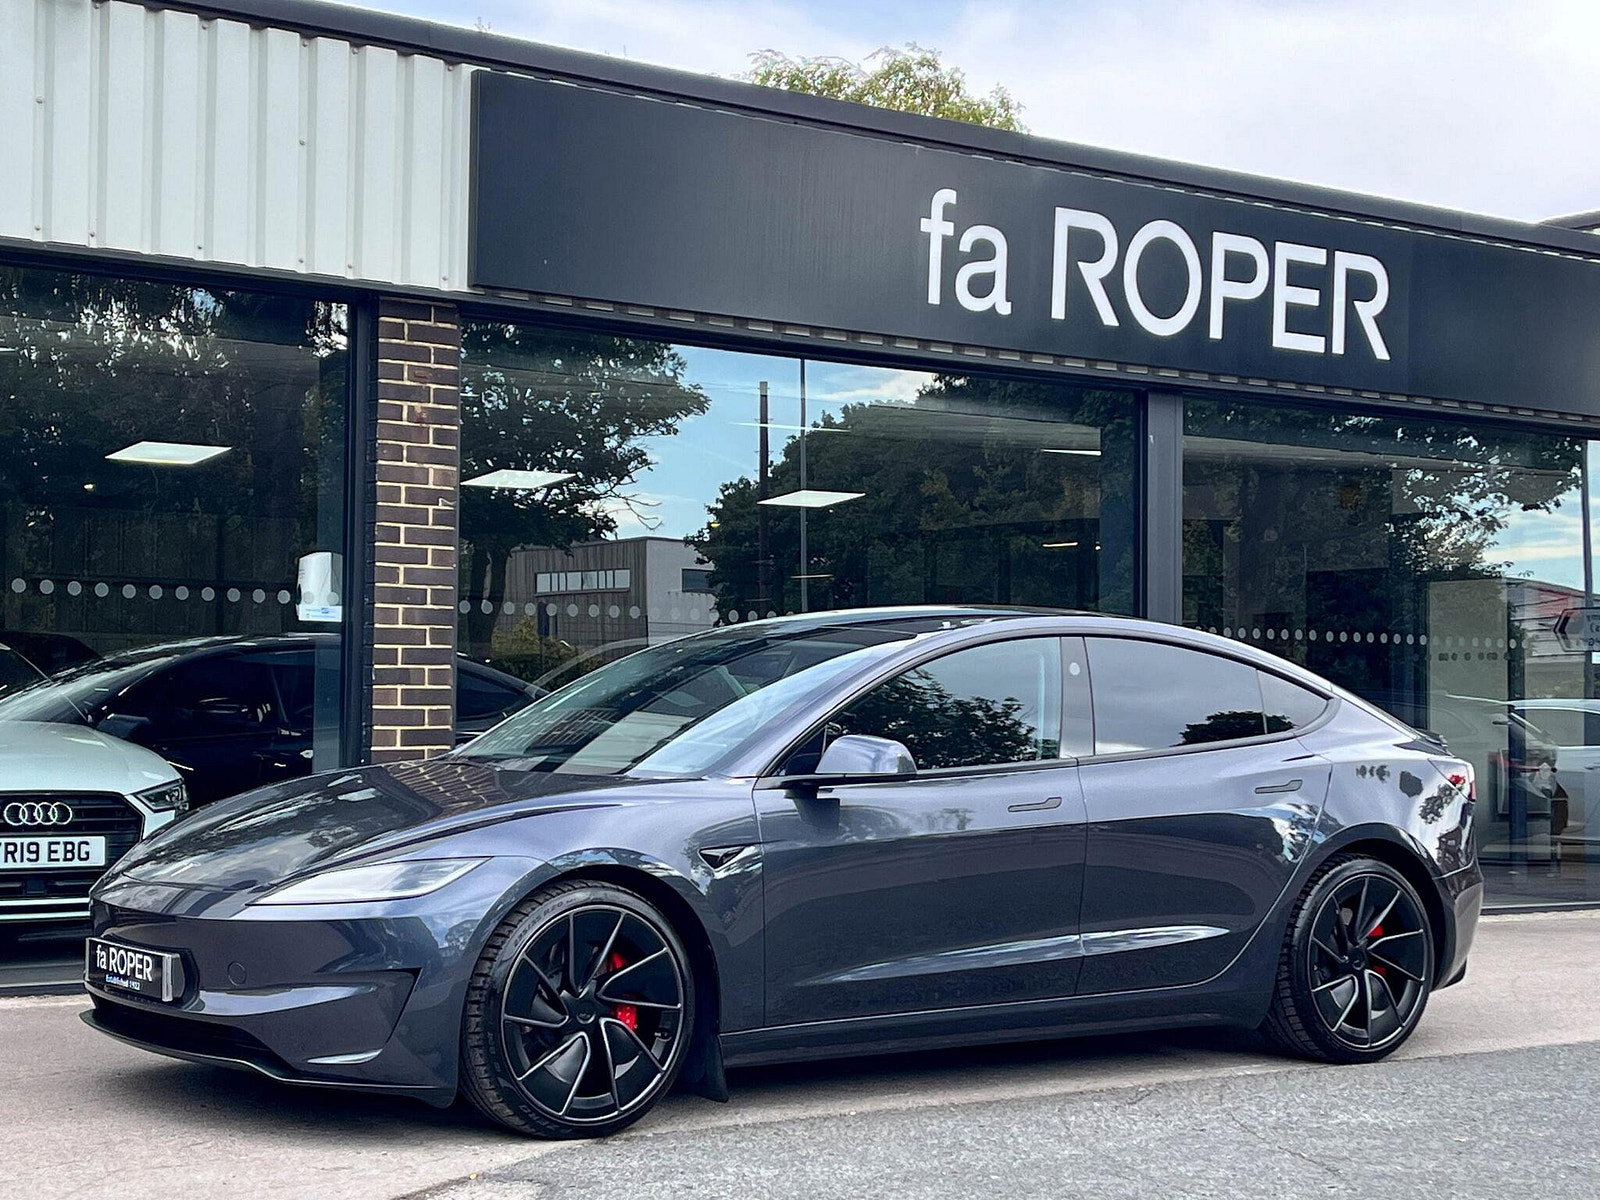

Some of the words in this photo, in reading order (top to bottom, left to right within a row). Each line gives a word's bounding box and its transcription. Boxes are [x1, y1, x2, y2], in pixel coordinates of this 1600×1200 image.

[919, 188, 1012, 316] fa
[1051, 206, 1390, 361] ROPER
[0, 841, 40, 863] R19
[47, 841, 90, 862] EBG
[96, 944, 107, 970] fa
[109, 947, 152, 982] ROPER
